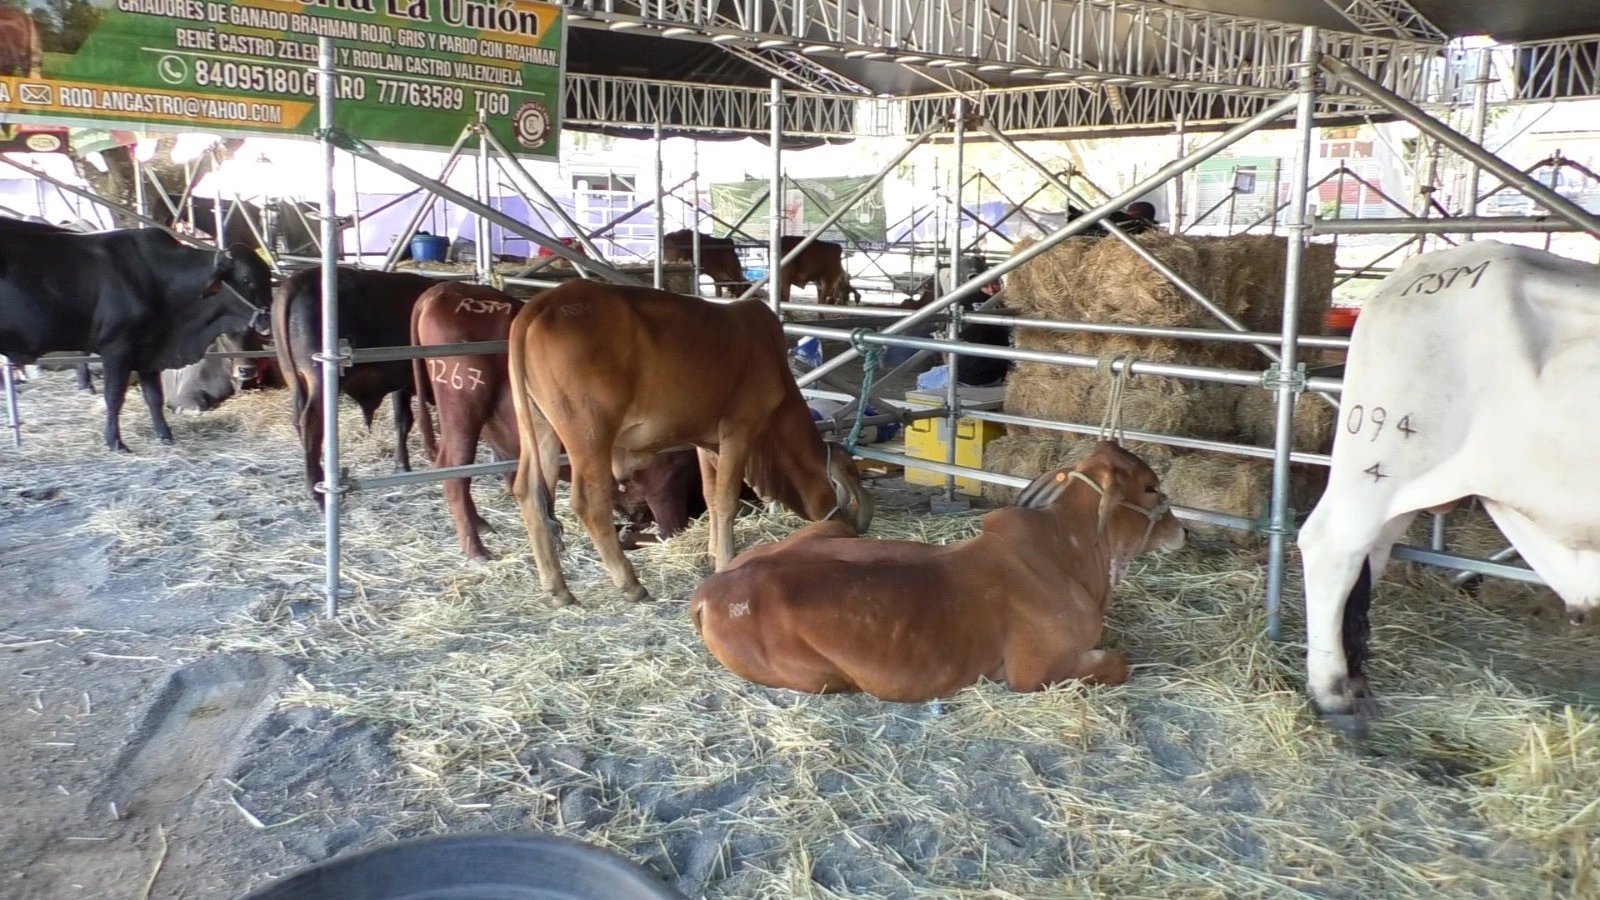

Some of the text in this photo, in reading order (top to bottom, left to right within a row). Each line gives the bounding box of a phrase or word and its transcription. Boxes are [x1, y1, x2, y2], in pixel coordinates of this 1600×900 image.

[118, 0, 204, 20] CRIADORES
[207, 3, 229, 23] DE
[231, 8, 287, 30] GANADO
[291, 13, 357, 39] BRAHMAN
[360, 23, 396, 46] ROJO,
[398, 28, 425, 49] GRIS
[427, 33, 438, 49] Y
[440, 35, 481, 55] PARDO
[480, 40, 503, 58] CON
[441, 0, 539, 37] Unión
[176, 28, 523, 86] RENÉ CASTRO ZELED Y RODLAN CASTRO VALENZUELA
[59, 86, 282, 123] RODLANCASTRO@YAHOO.COM
[195, 60, 301, 94] 84095180
[376, 79, 463, 111] 77763589
[474, 90, 509, 115] TIGO
[455, 297, 512, 315] RSM
[427, 359, 486, 390] 1267
